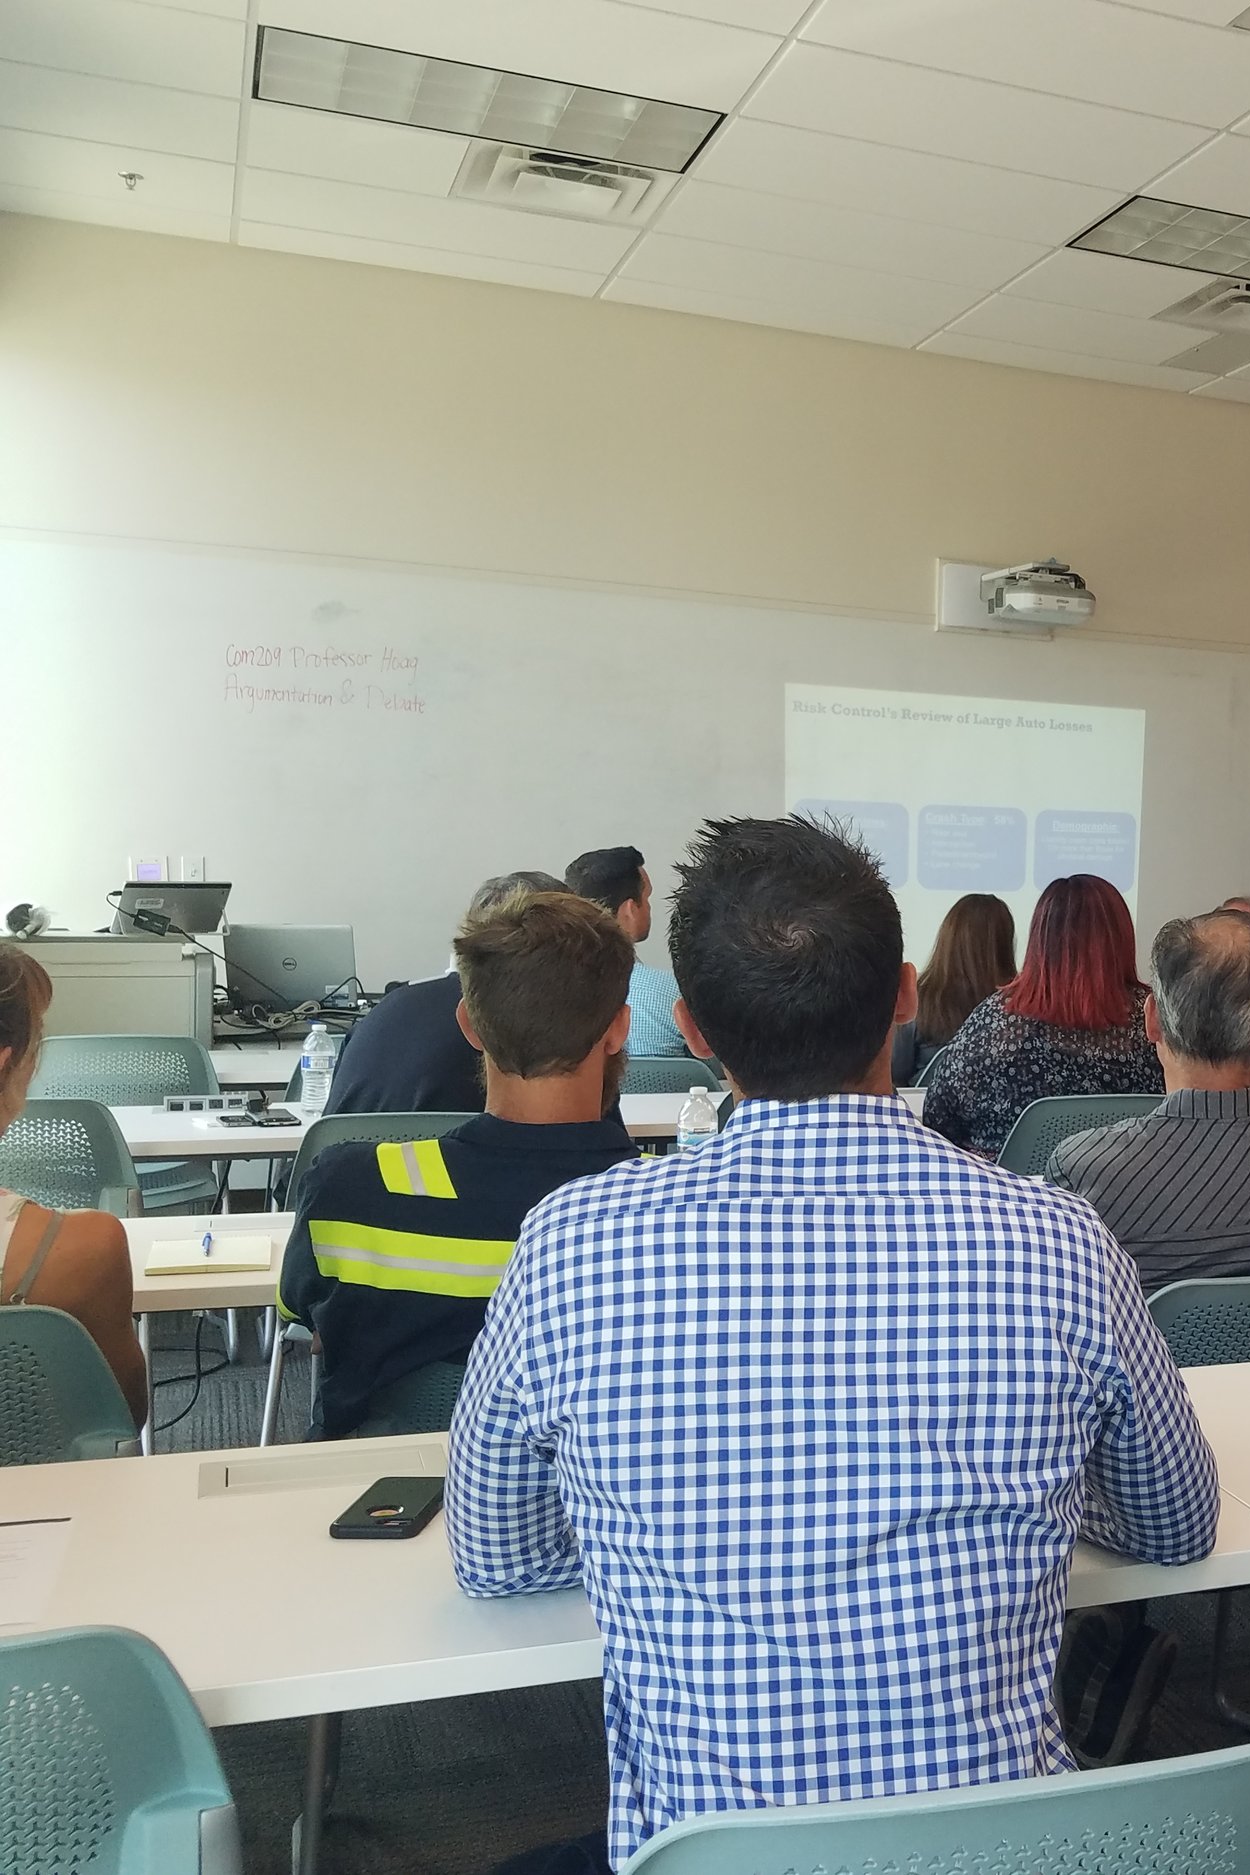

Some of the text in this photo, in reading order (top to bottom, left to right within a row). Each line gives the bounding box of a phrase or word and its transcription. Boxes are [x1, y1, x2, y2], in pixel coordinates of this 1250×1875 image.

[289, 646, 373, 668] Professor
[224, 672, 426, 714] Argumentation & Debate
[792, 700, 1093, 732] Risk Control's Review of Large Auto Losses
